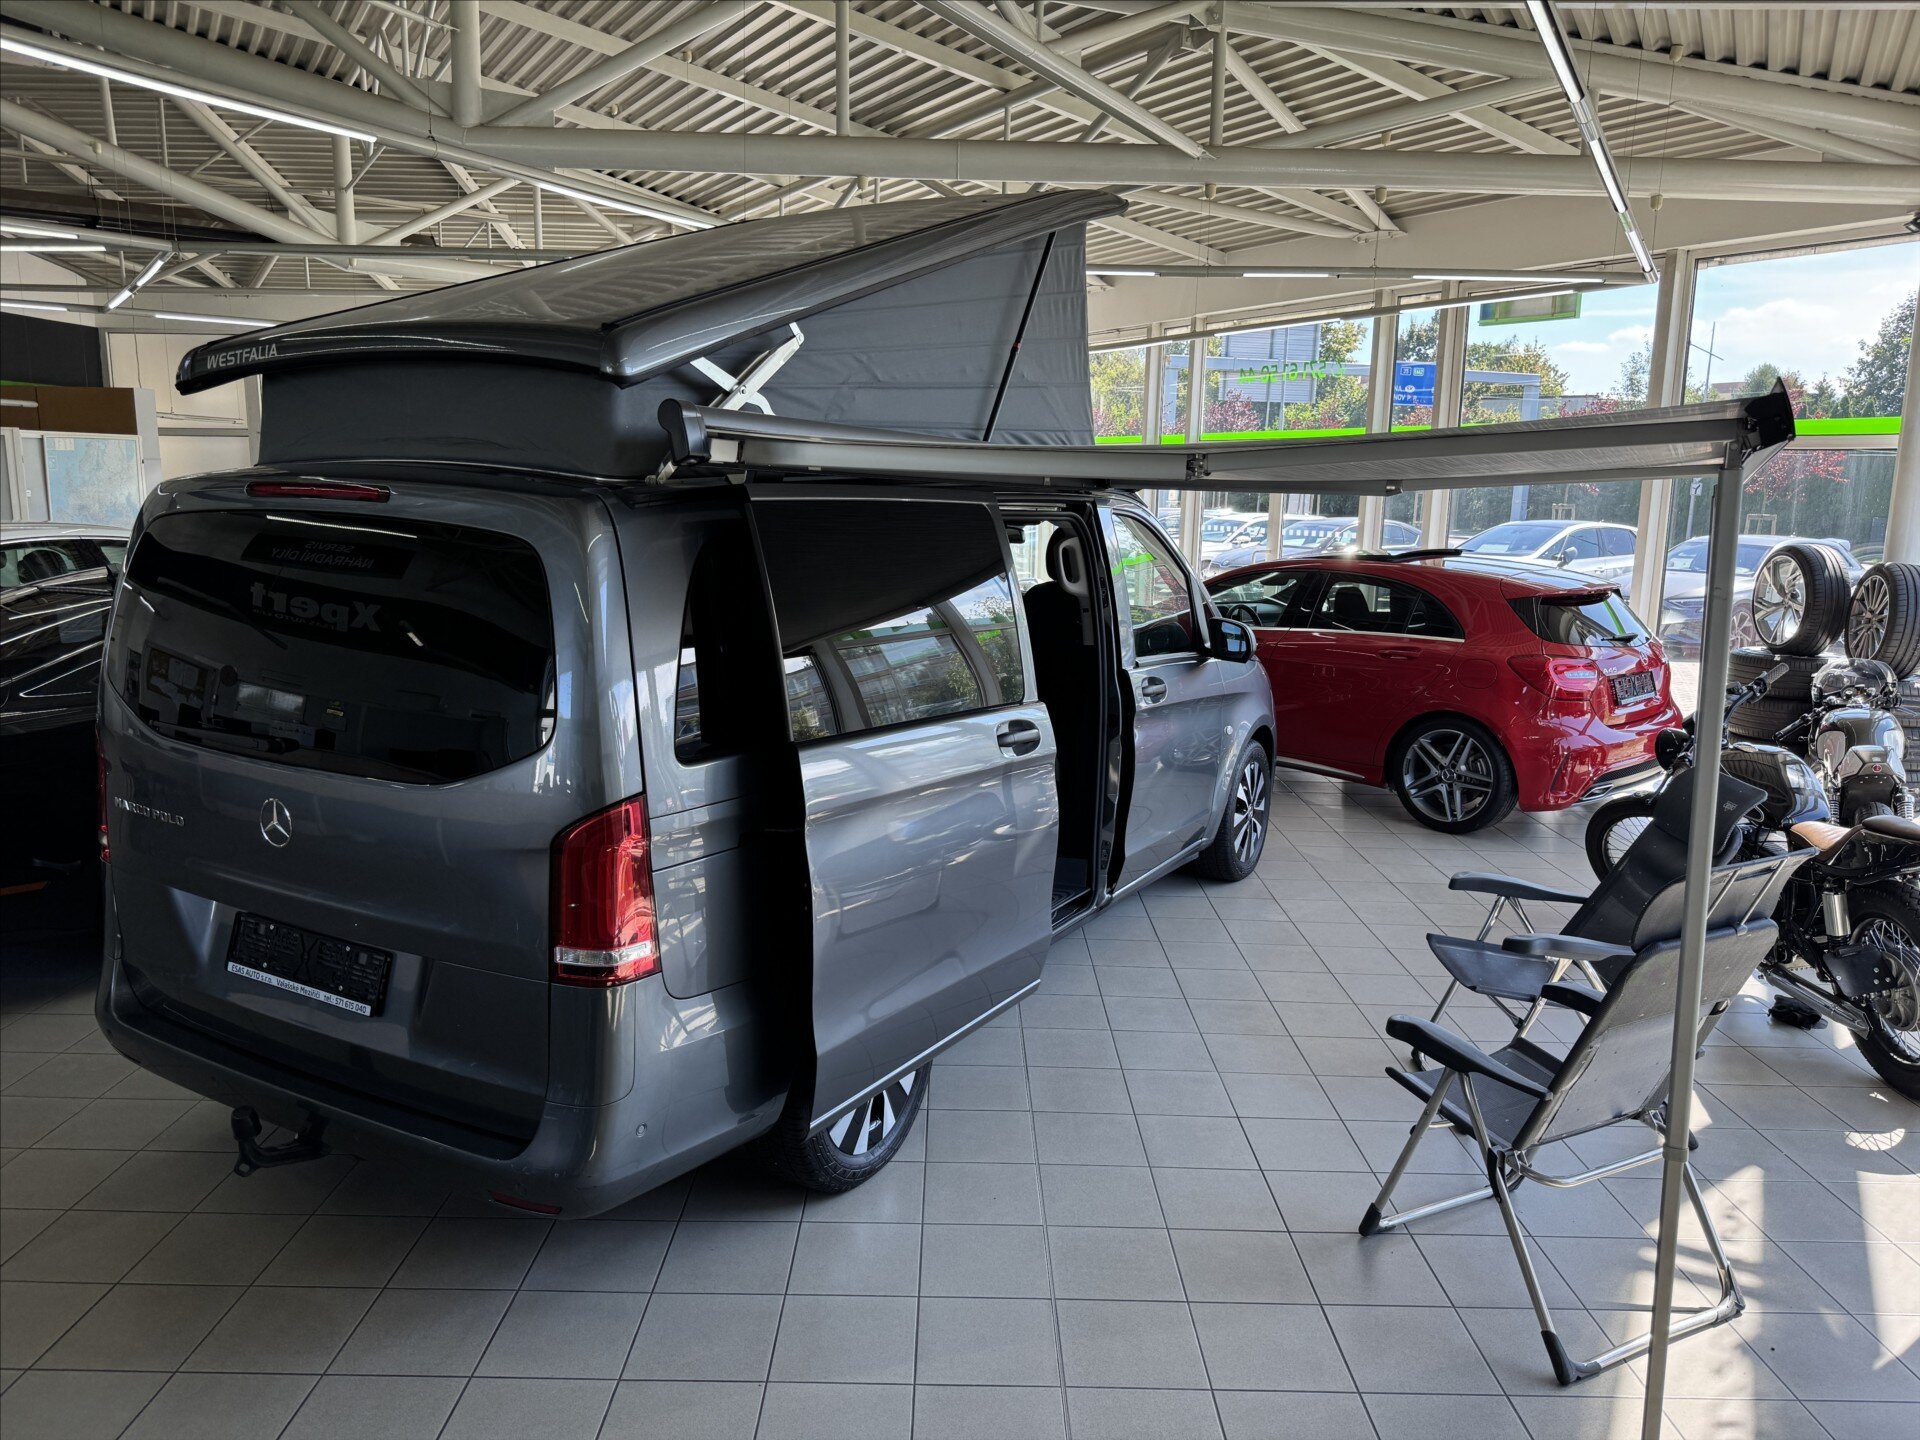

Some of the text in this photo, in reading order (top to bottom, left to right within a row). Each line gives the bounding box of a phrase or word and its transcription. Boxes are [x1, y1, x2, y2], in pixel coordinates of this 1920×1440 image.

[207, 343, 277, 370] WESTFALIA
[114, 796, 185, 827] MARCO POLO
[231, 964, 245, 975] ESAS
[245, 968, 260, 980] AUTO
[335, 997, 344, 1008] 571
[345, 1001, 354, 1010] 615
[355, 1004, 367, 1013] 040
